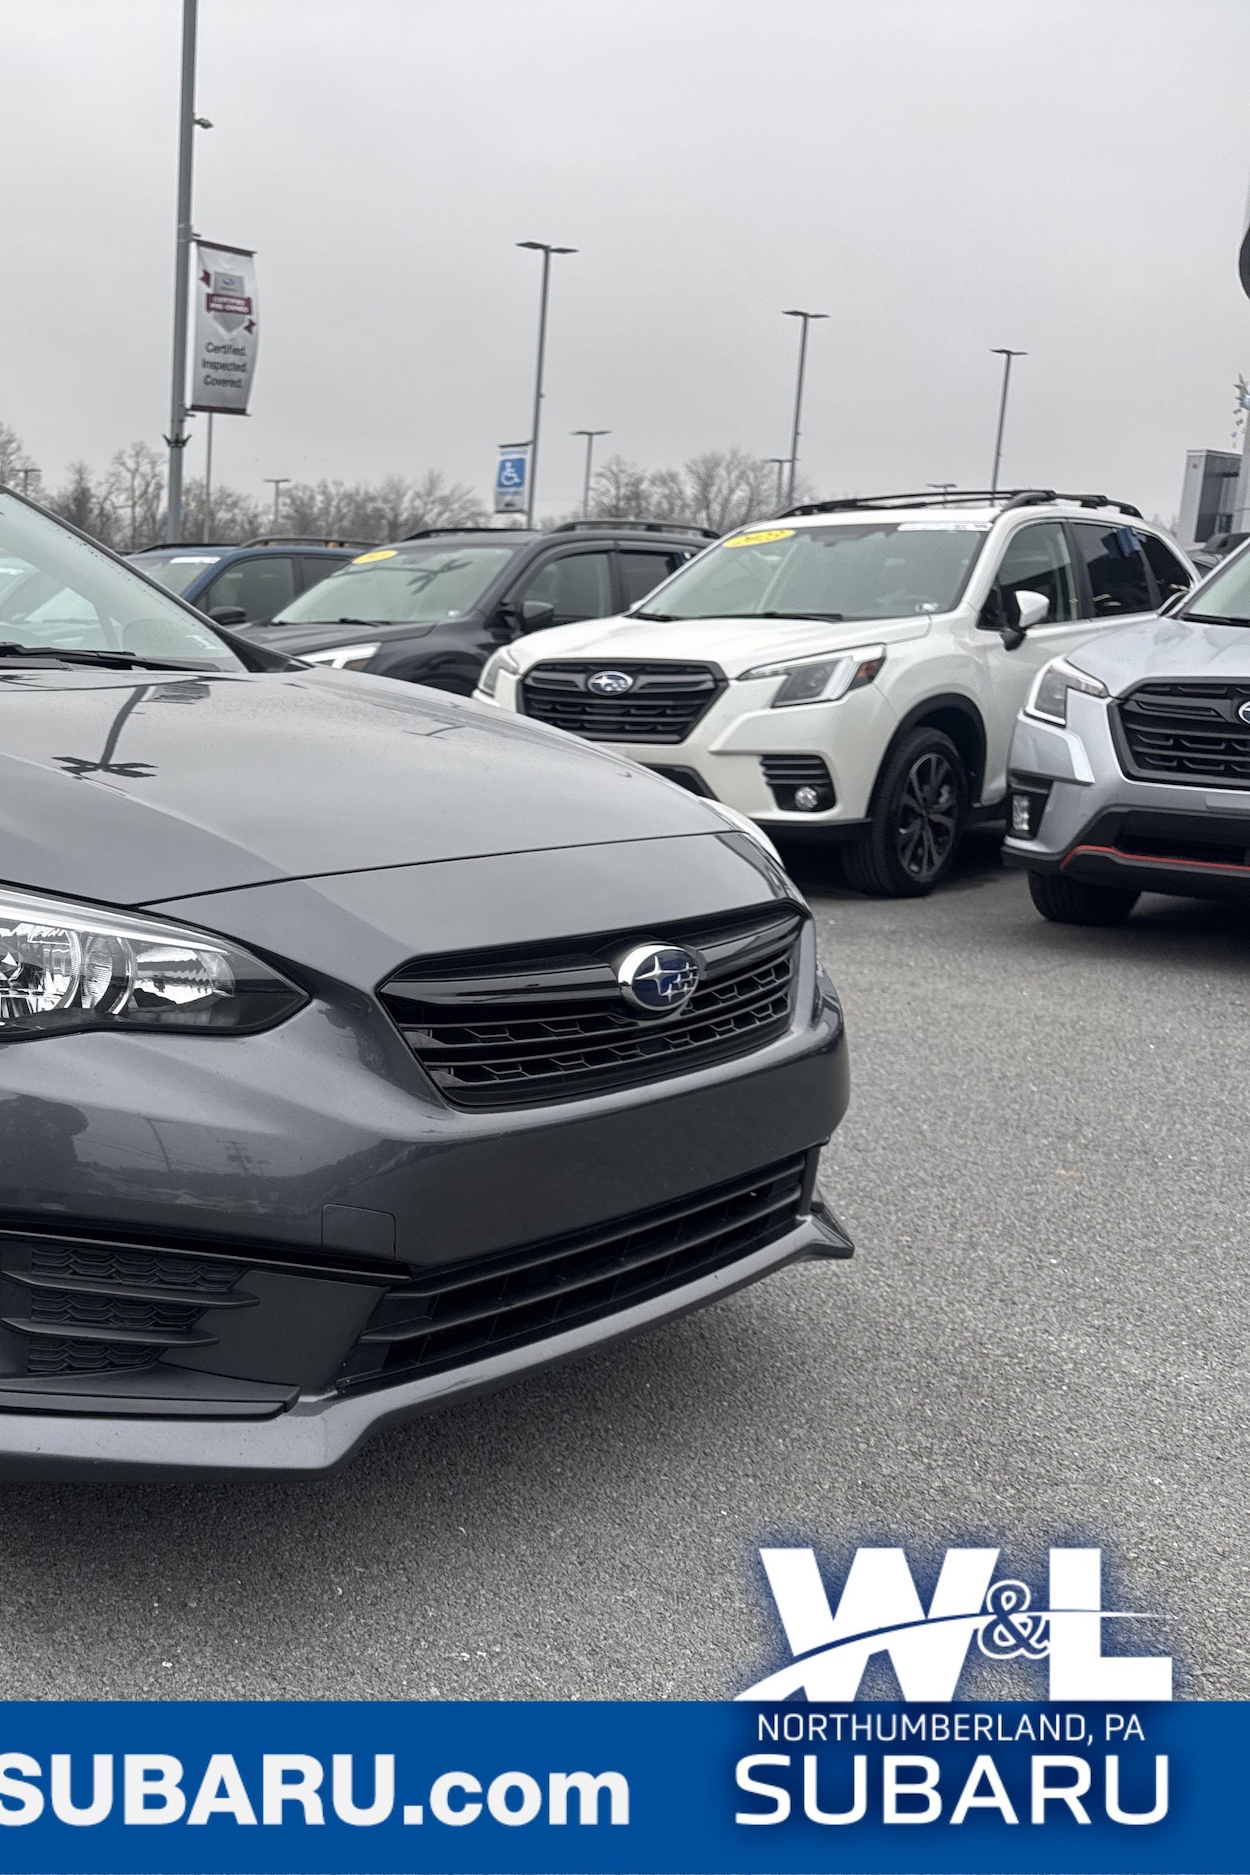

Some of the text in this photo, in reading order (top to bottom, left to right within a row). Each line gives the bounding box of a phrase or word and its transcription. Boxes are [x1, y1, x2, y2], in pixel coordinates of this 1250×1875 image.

[205, 342, 248, 357] Certified.
[202, 358, 249, 373] Inspected.
[203, 375, 244, 389] Covered.
